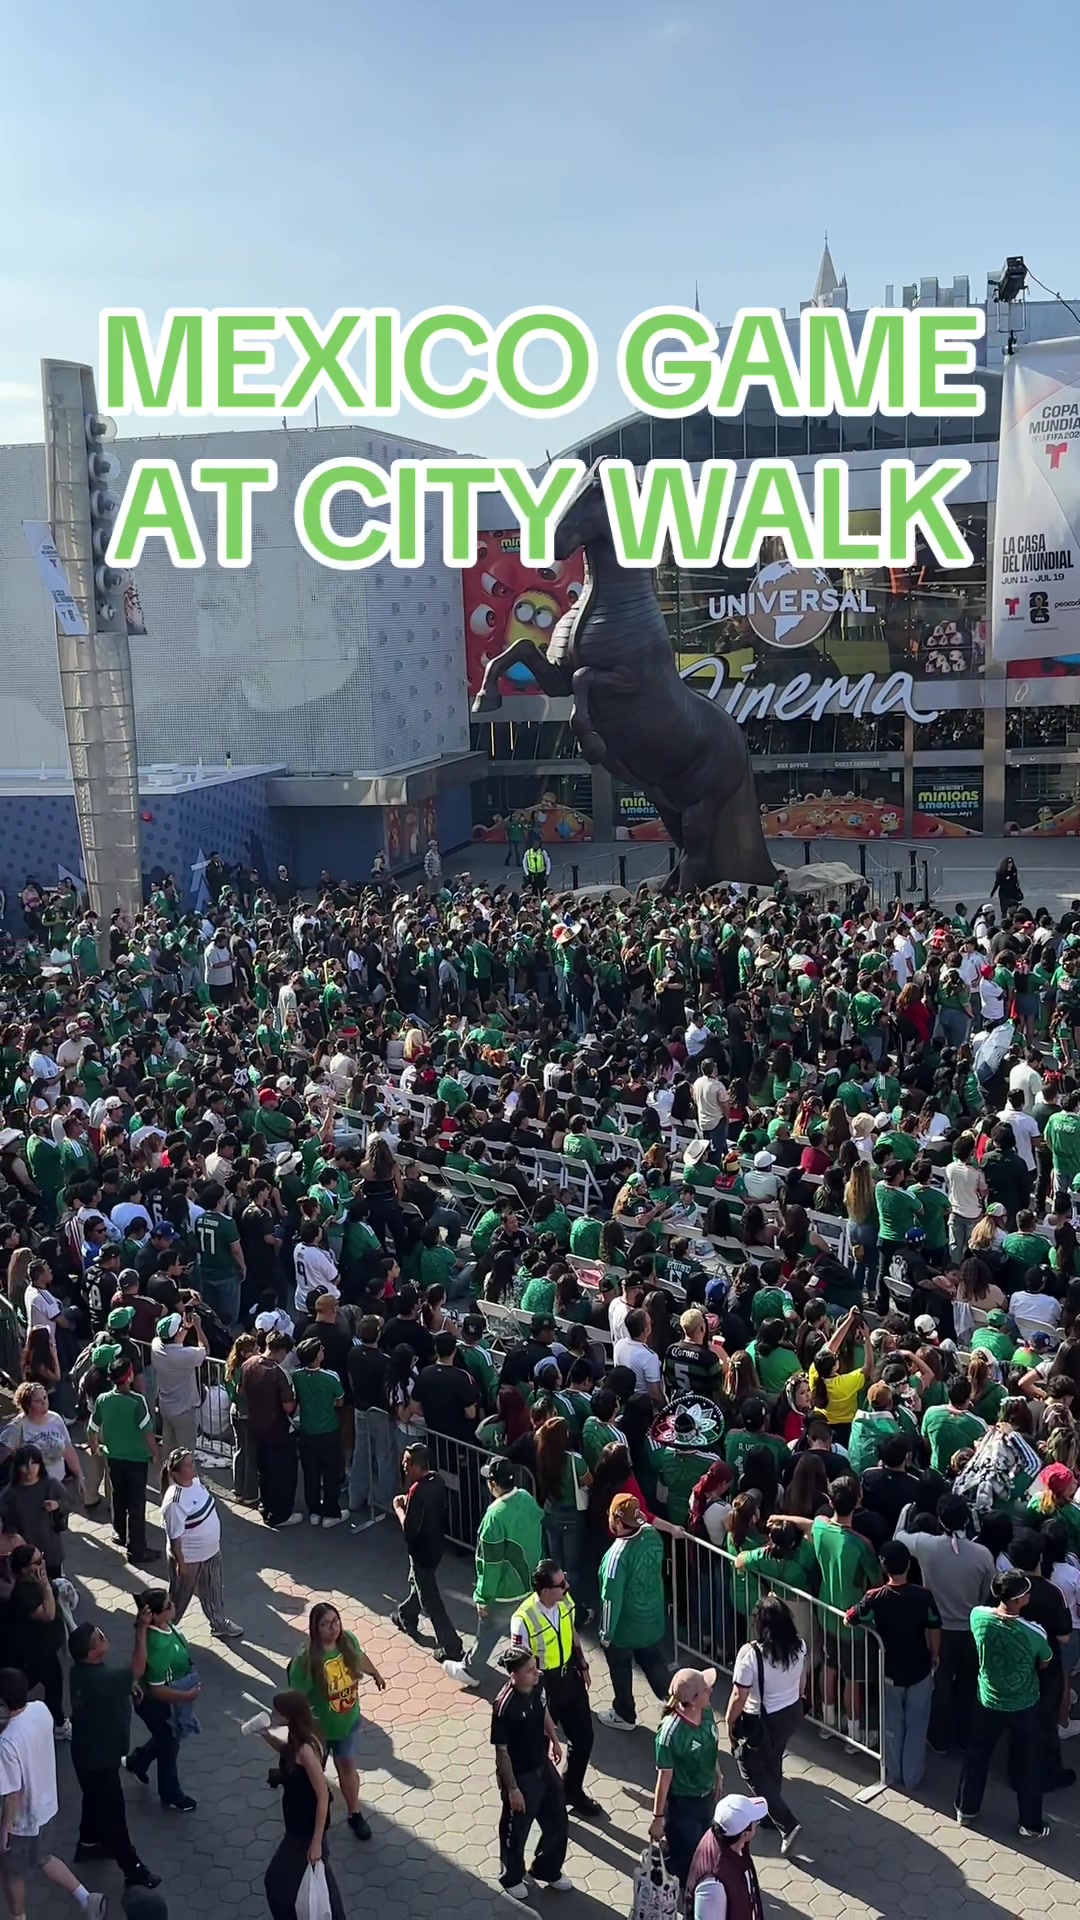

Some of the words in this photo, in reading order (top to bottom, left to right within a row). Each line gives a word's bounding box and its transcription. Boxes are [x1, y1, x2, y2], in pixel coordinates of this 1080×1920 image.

[1042, 403, 1079, 419] COPA
[1046, 433, 1063, 441] FIFA
[1003, 537, 1015, 555] LA
[1017, 534, 1046, 554] CASA
[1002, 555, 1019, 574] DEL
[1022, 550, 1074, 572] MUNDIAL
[1001, 577, 1018, 585] JUN
[1020, 576, 1028, 584] 11
[1035, 575, 1052, 583] JUL
[1053, 573, 1065, 581] 19
[708, 589, 876, 621] UNIVERSAL
[853, 760, 880, 768] SERVICES
[918, 790, 979, 802] minions
[297, 1261, 308, 1286] 9
[671, 1346, 700, 1361] Corona
[675, 1363, 691, 1391] 5
